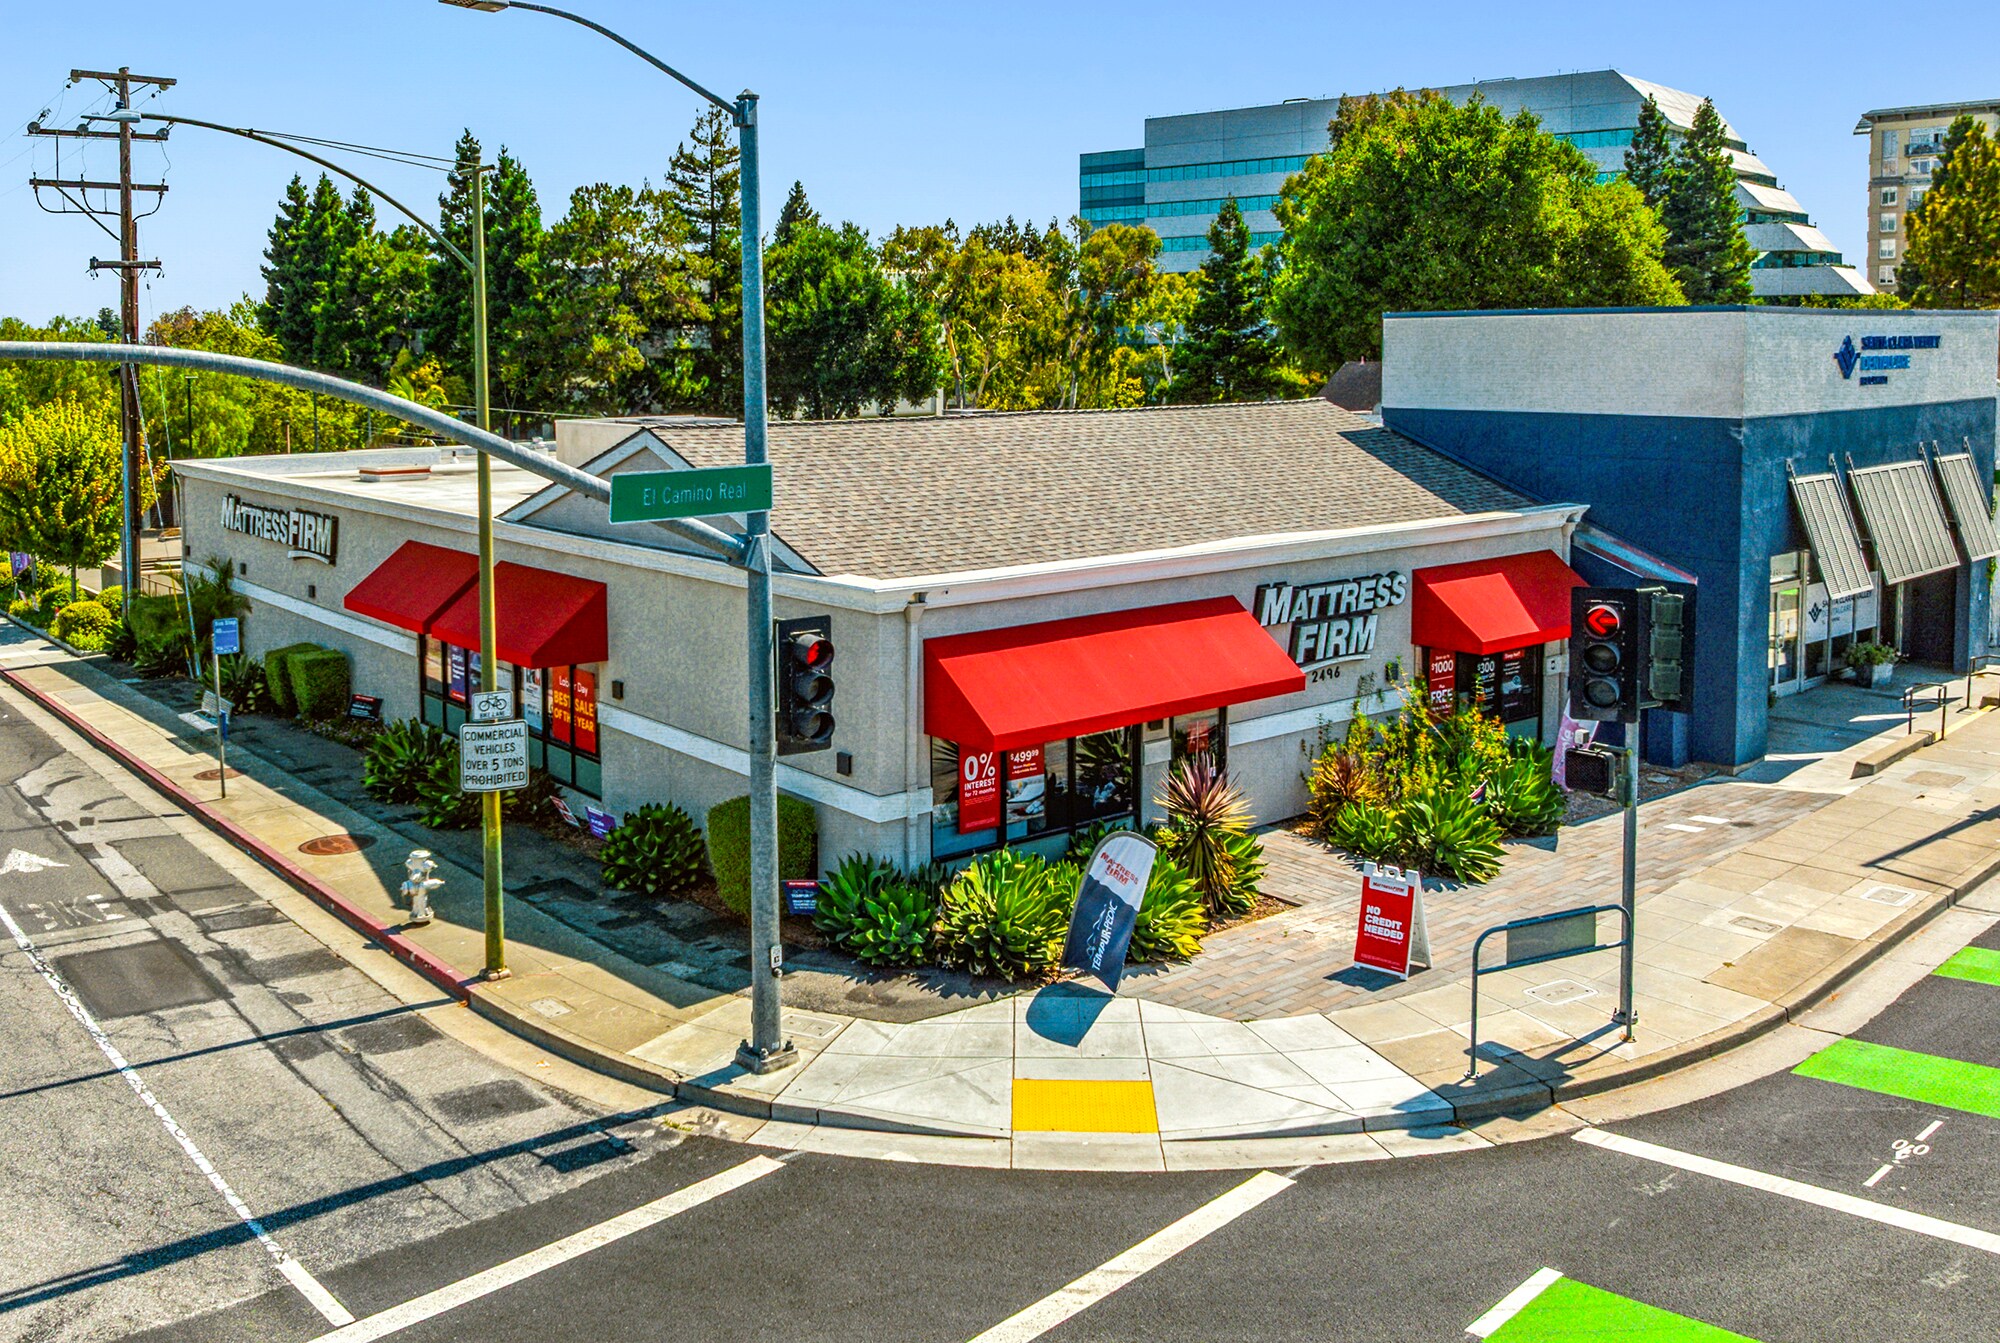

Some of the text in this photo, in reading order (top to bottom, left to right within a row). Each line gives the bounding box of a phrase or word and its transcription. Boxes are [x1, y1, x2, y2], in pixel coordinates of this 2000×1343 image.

[643, 481, 746, 506] El Camino Real
[1260, 574, 1408, 627] MATTRESS
[1295, 614, 1379, 665] FIRM
[1311, 666, 1341, 683] 2496
[1431, 660, 1454, 674] $1000
[1477, 661, 1495, 674] $300
[577, 682, 589, 697] Day
[1430, 688, 1454, 704] FREE
[574, 698, 594, 717] SALE
[553, 707, 563, 719] OF
[577, 716, 594, 732] YEAR
[464, 728, 525, 741] COMMERCIAL
[475, 742, 516, 755] VEHICLES
[465, 757, 525, 771] OVER 5 TONS
[964, 752, 996, 781] 0%
[465, 771, 526, 785] PROHIBITED
[964, 777, 996, 791] INTEREST
[978, 787, 996, 795] months
[1100, 851, 1139, 886] MATTRESS
[1105, 864, 1130, 885] FIRM
[27, 893, 126, 930] BIKE
[1366, 904, 1381, 915] NO
[1364, 914, 1403, 931] CREDIT
[1363, 923, 1404, 940] NEEDED
